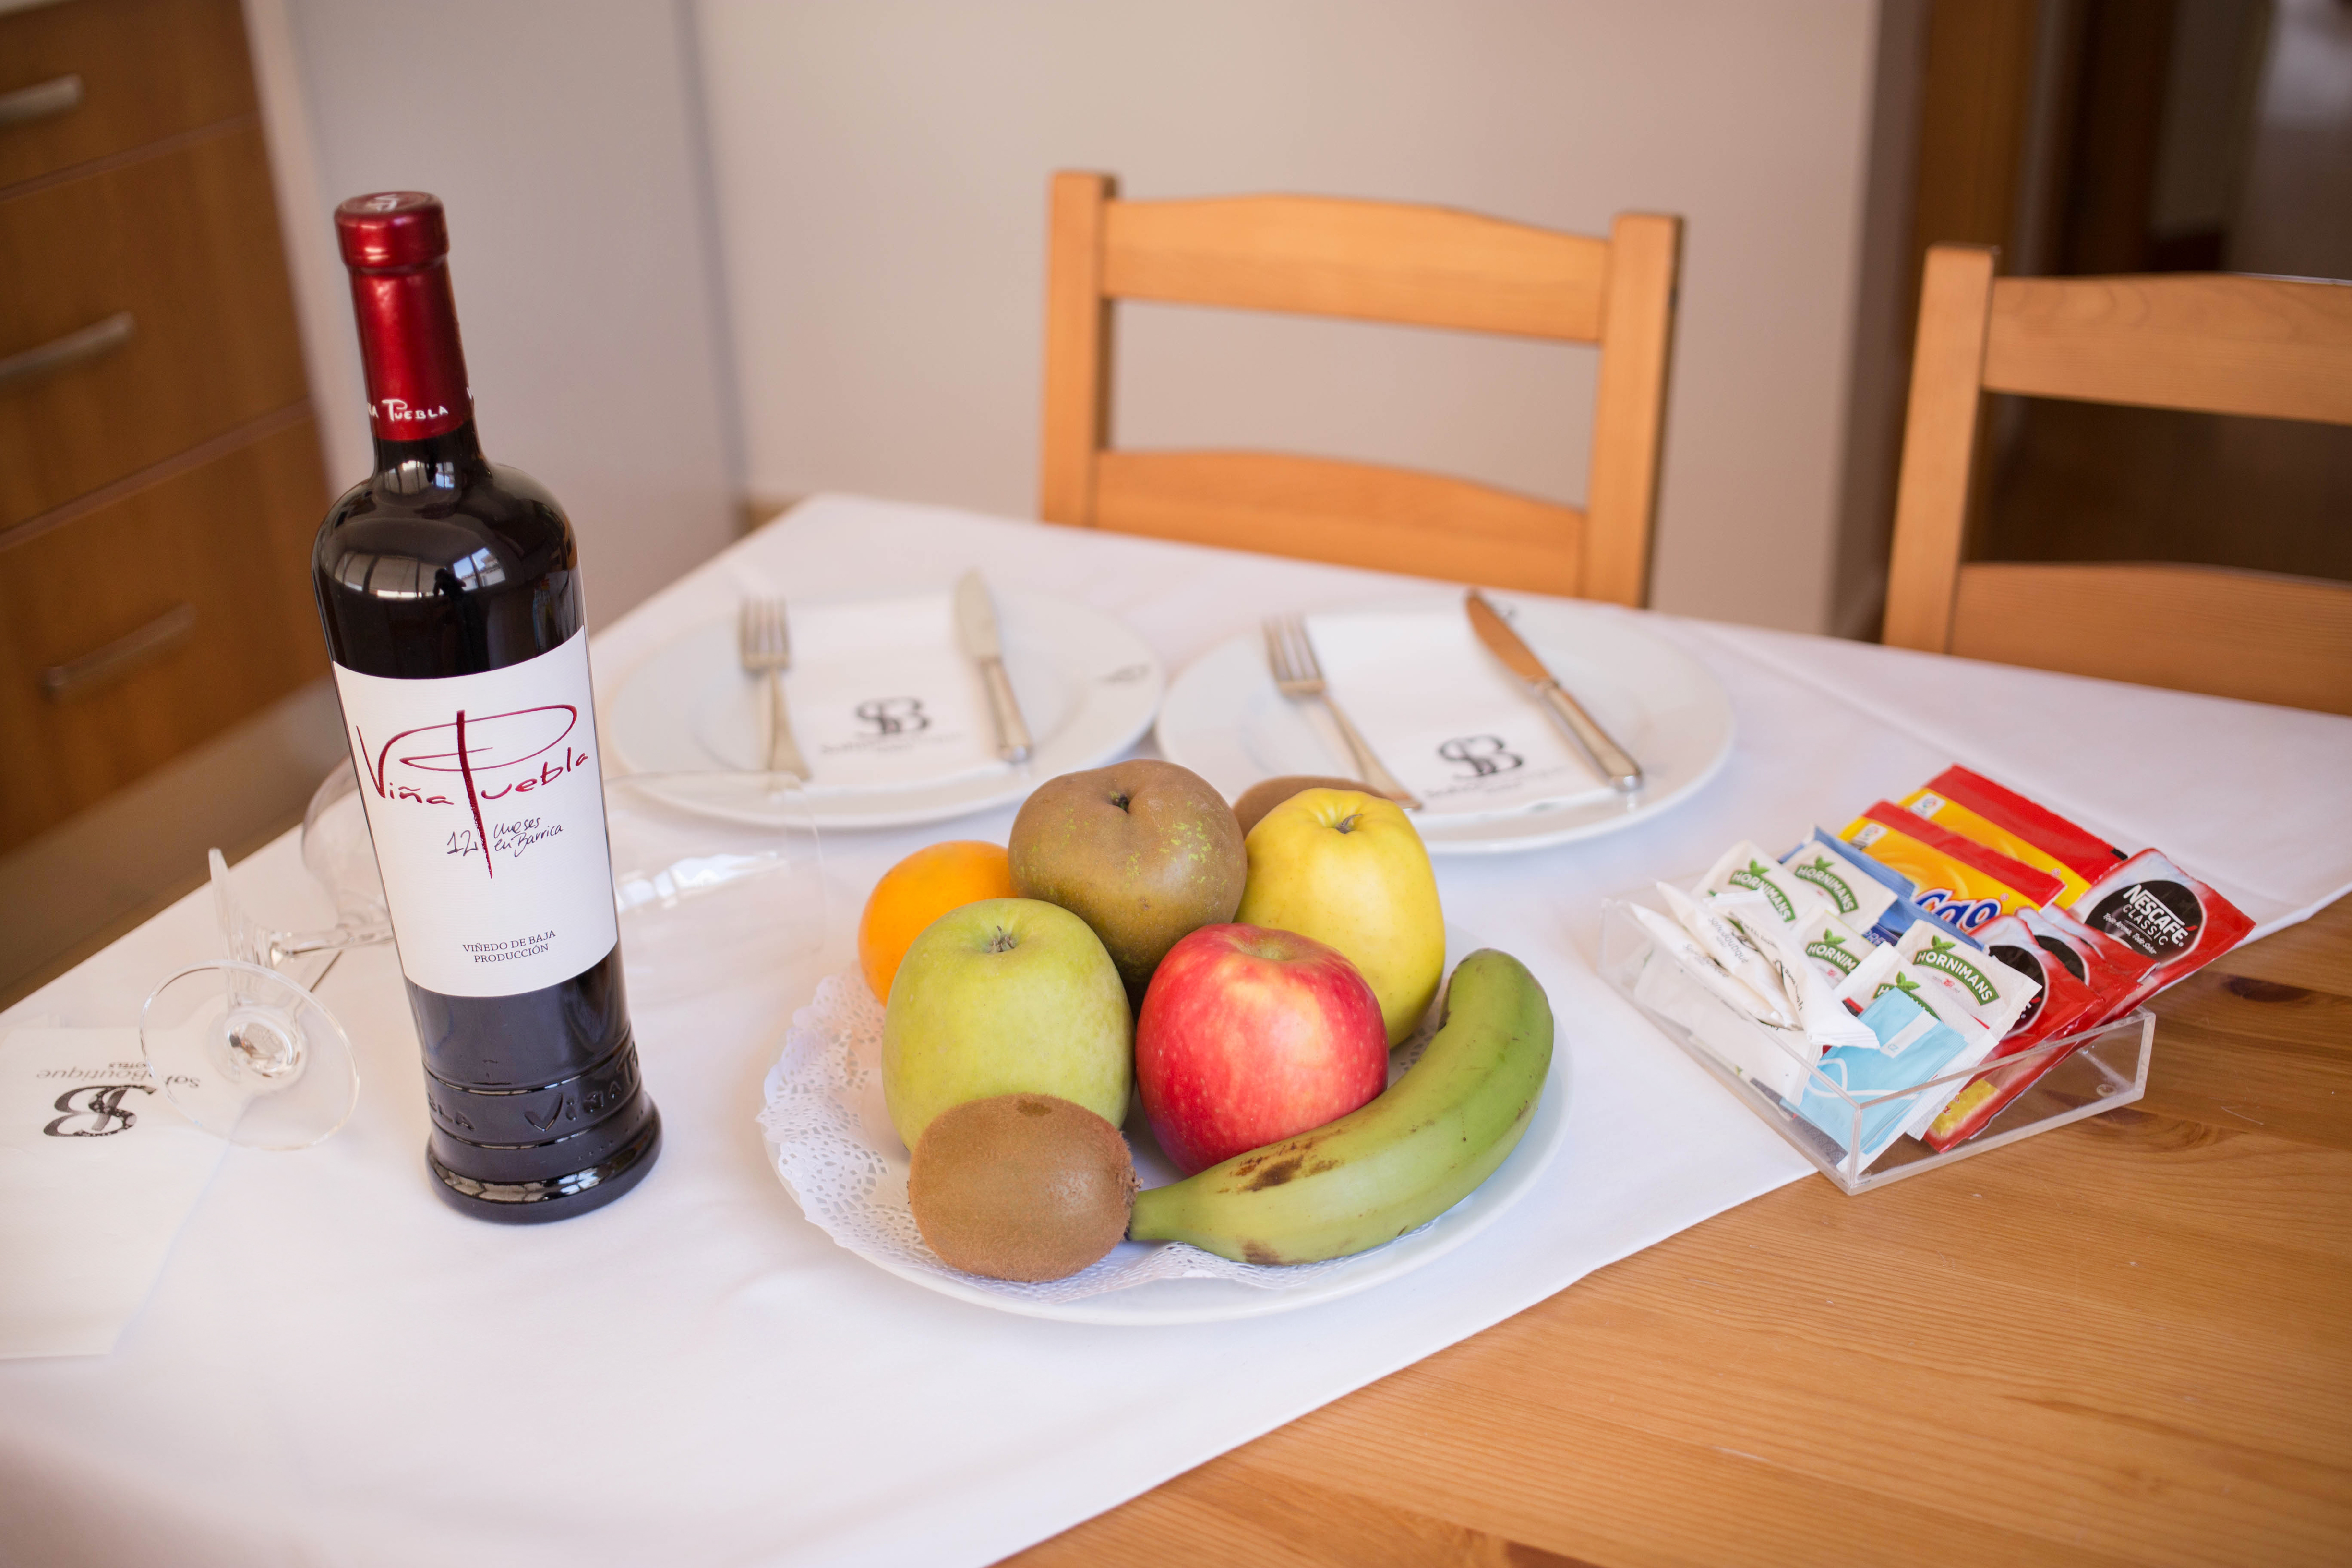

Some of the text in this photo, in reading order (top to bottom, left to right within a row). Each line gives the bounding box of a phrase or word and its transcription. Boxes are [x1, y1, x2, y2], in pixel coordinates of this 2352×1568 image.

[356, 725, 454, 805] Viña
[447, 830, 479, 857] 12
[1731, 871, 1791, 922] HORNIMANS
[1796, 866, 1854, 911] HORNIMANS
[462, 930, 556, 952] VIÑEDO DE BAJA
[2123, 904, 2168, 946] CLASSIC
[474, 943, 549, 963] PRODUCCIÓN
[1917, 951, 1992, 1001] HORNIMANS
